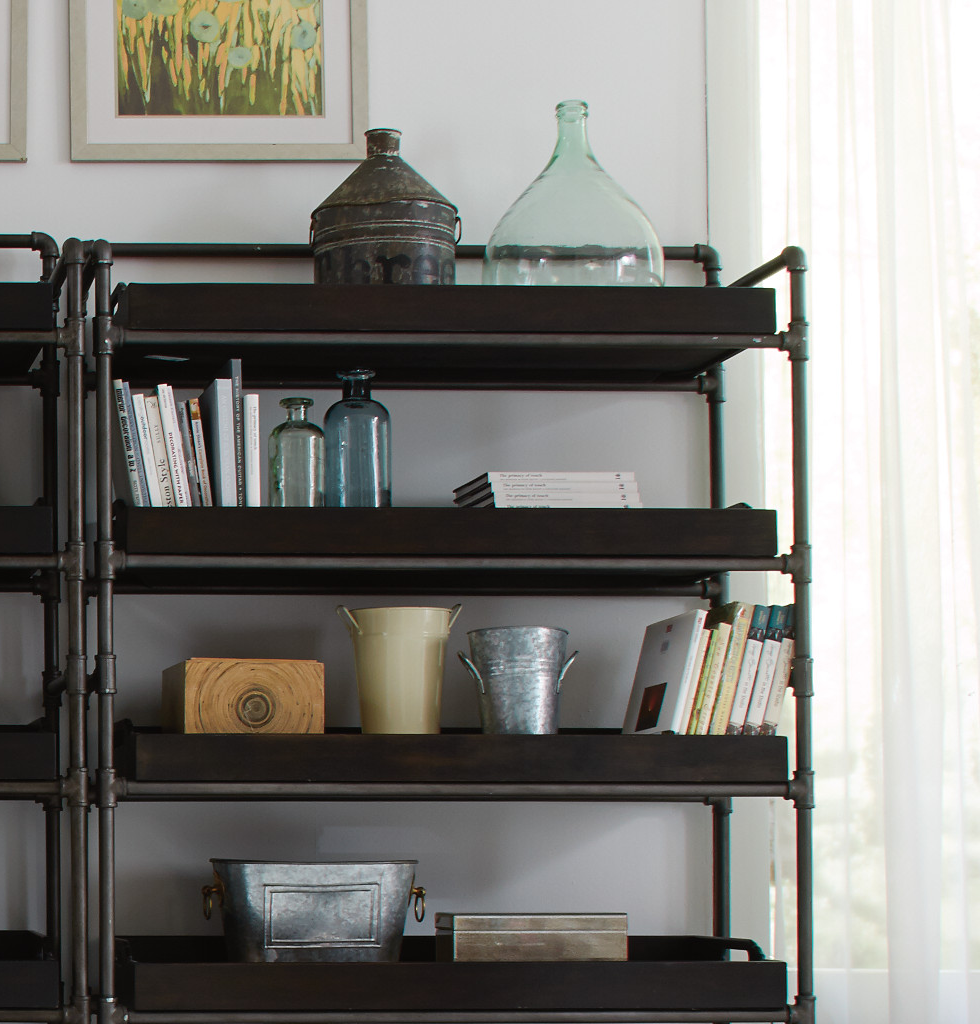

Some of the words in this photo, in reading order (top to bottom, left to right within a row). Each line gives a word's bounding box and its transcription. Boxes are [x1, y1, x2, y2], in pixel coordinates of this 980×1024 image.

[140, 416, 148, 440] outdoor
[158, 459, 169, 483] Style
[168, 432, 178, 468] DECORATING
[176, 485, 184, 503] PAPER
